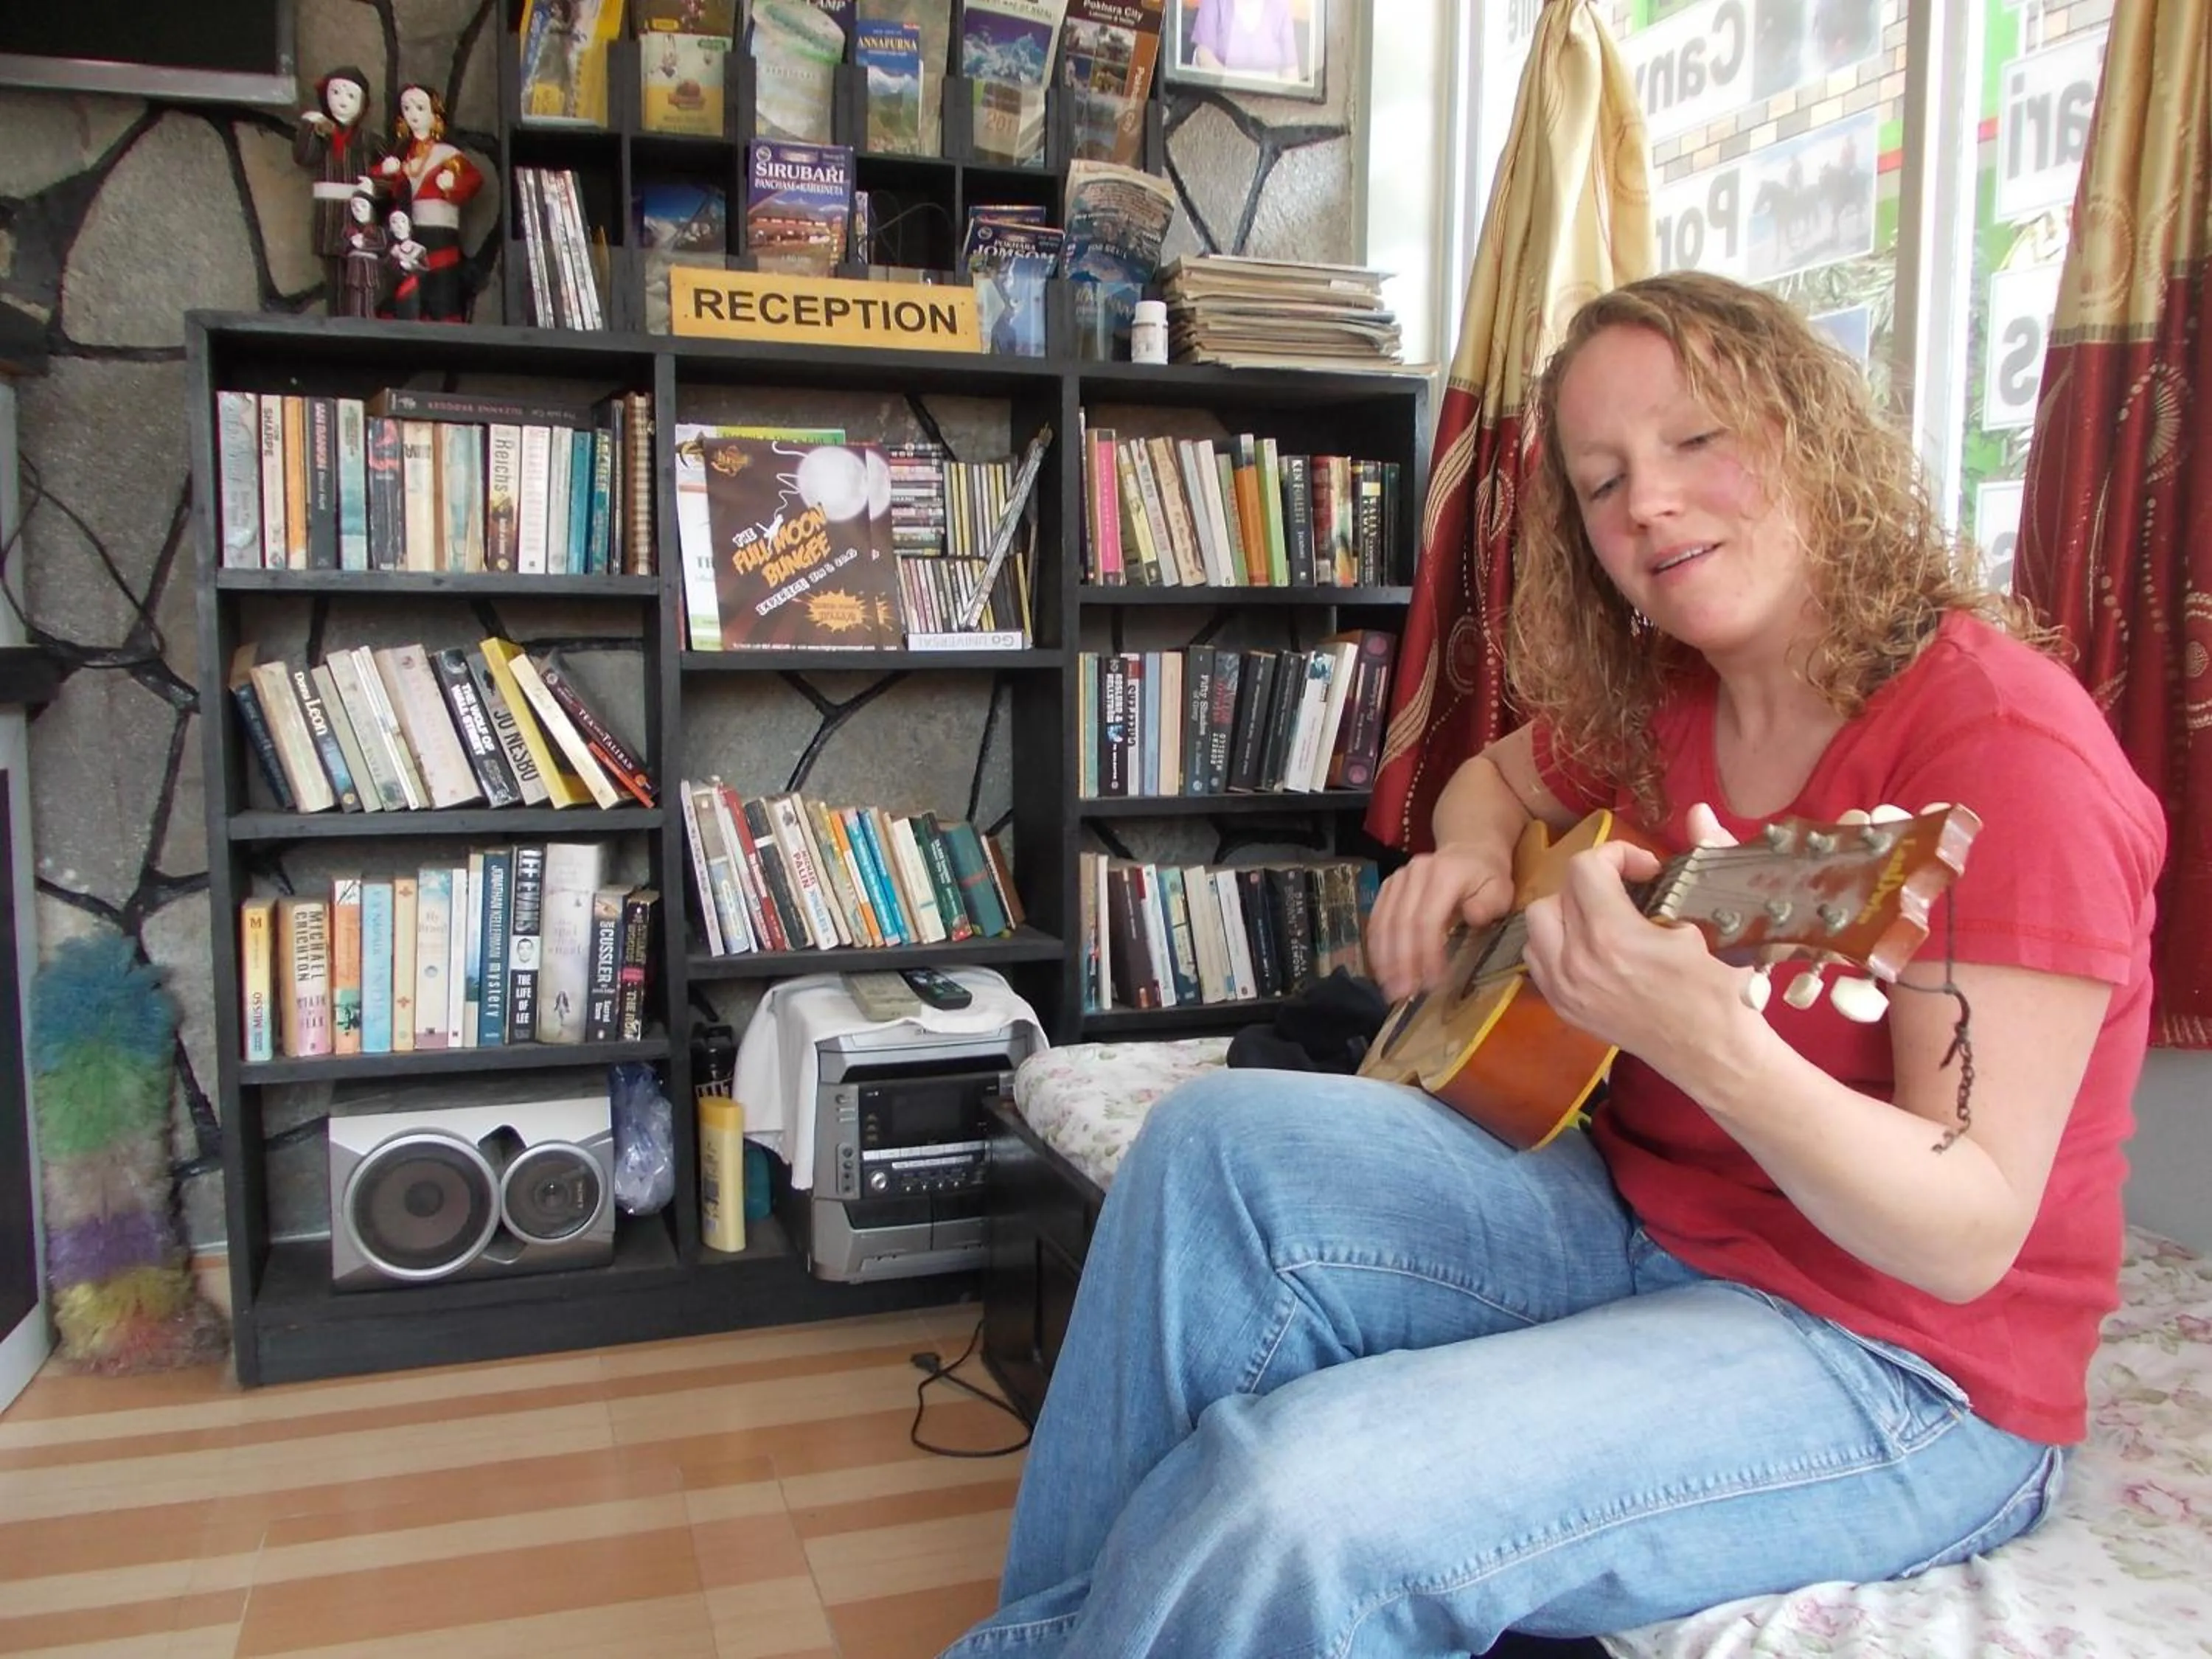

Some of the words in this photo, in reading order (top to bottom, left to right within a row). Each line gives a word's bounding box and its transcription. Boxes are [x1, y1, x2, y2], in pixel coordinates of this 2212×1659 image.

[858, 35, 917, 51] ANNAPURNA
[755, 161, 844, 184] SIRUBARI
[693, 288, 958, 335] RECEPTION
[263, 407, 274, 457] SHARPE
[494, 437, 515, 494] Reichs
[1291, 459, 1304, 481] KEN
[732, 542, 771, 576] FULL
[775, 504, 827, 554] MOON
[762, 531, 832, 588] BUNGEE
[294, 671, 311, 700] Donna
[305, 698, 329, 736] Leon
[459, 682, 477, 704] THE
[467, 703, 492, 735] WOLF
[481, 734, 497, 753] OF
[491, 865, 504, 909] JONATHAN
[793, 852, 812, 889] PALIN
[295, 911, 310, 982] CRICHTON
[309, 911, 325, 980] MICHAEL
[597, 927, 615, 989] CUSSLER
[516, 987, 532, 999] LIFE
[518, 973, 532, 987] THE
[253, 992, 263, 1029] MUSSO
[516, 1012, 530, 1025] LEE
[518, 1000, 529, 1012] OF
